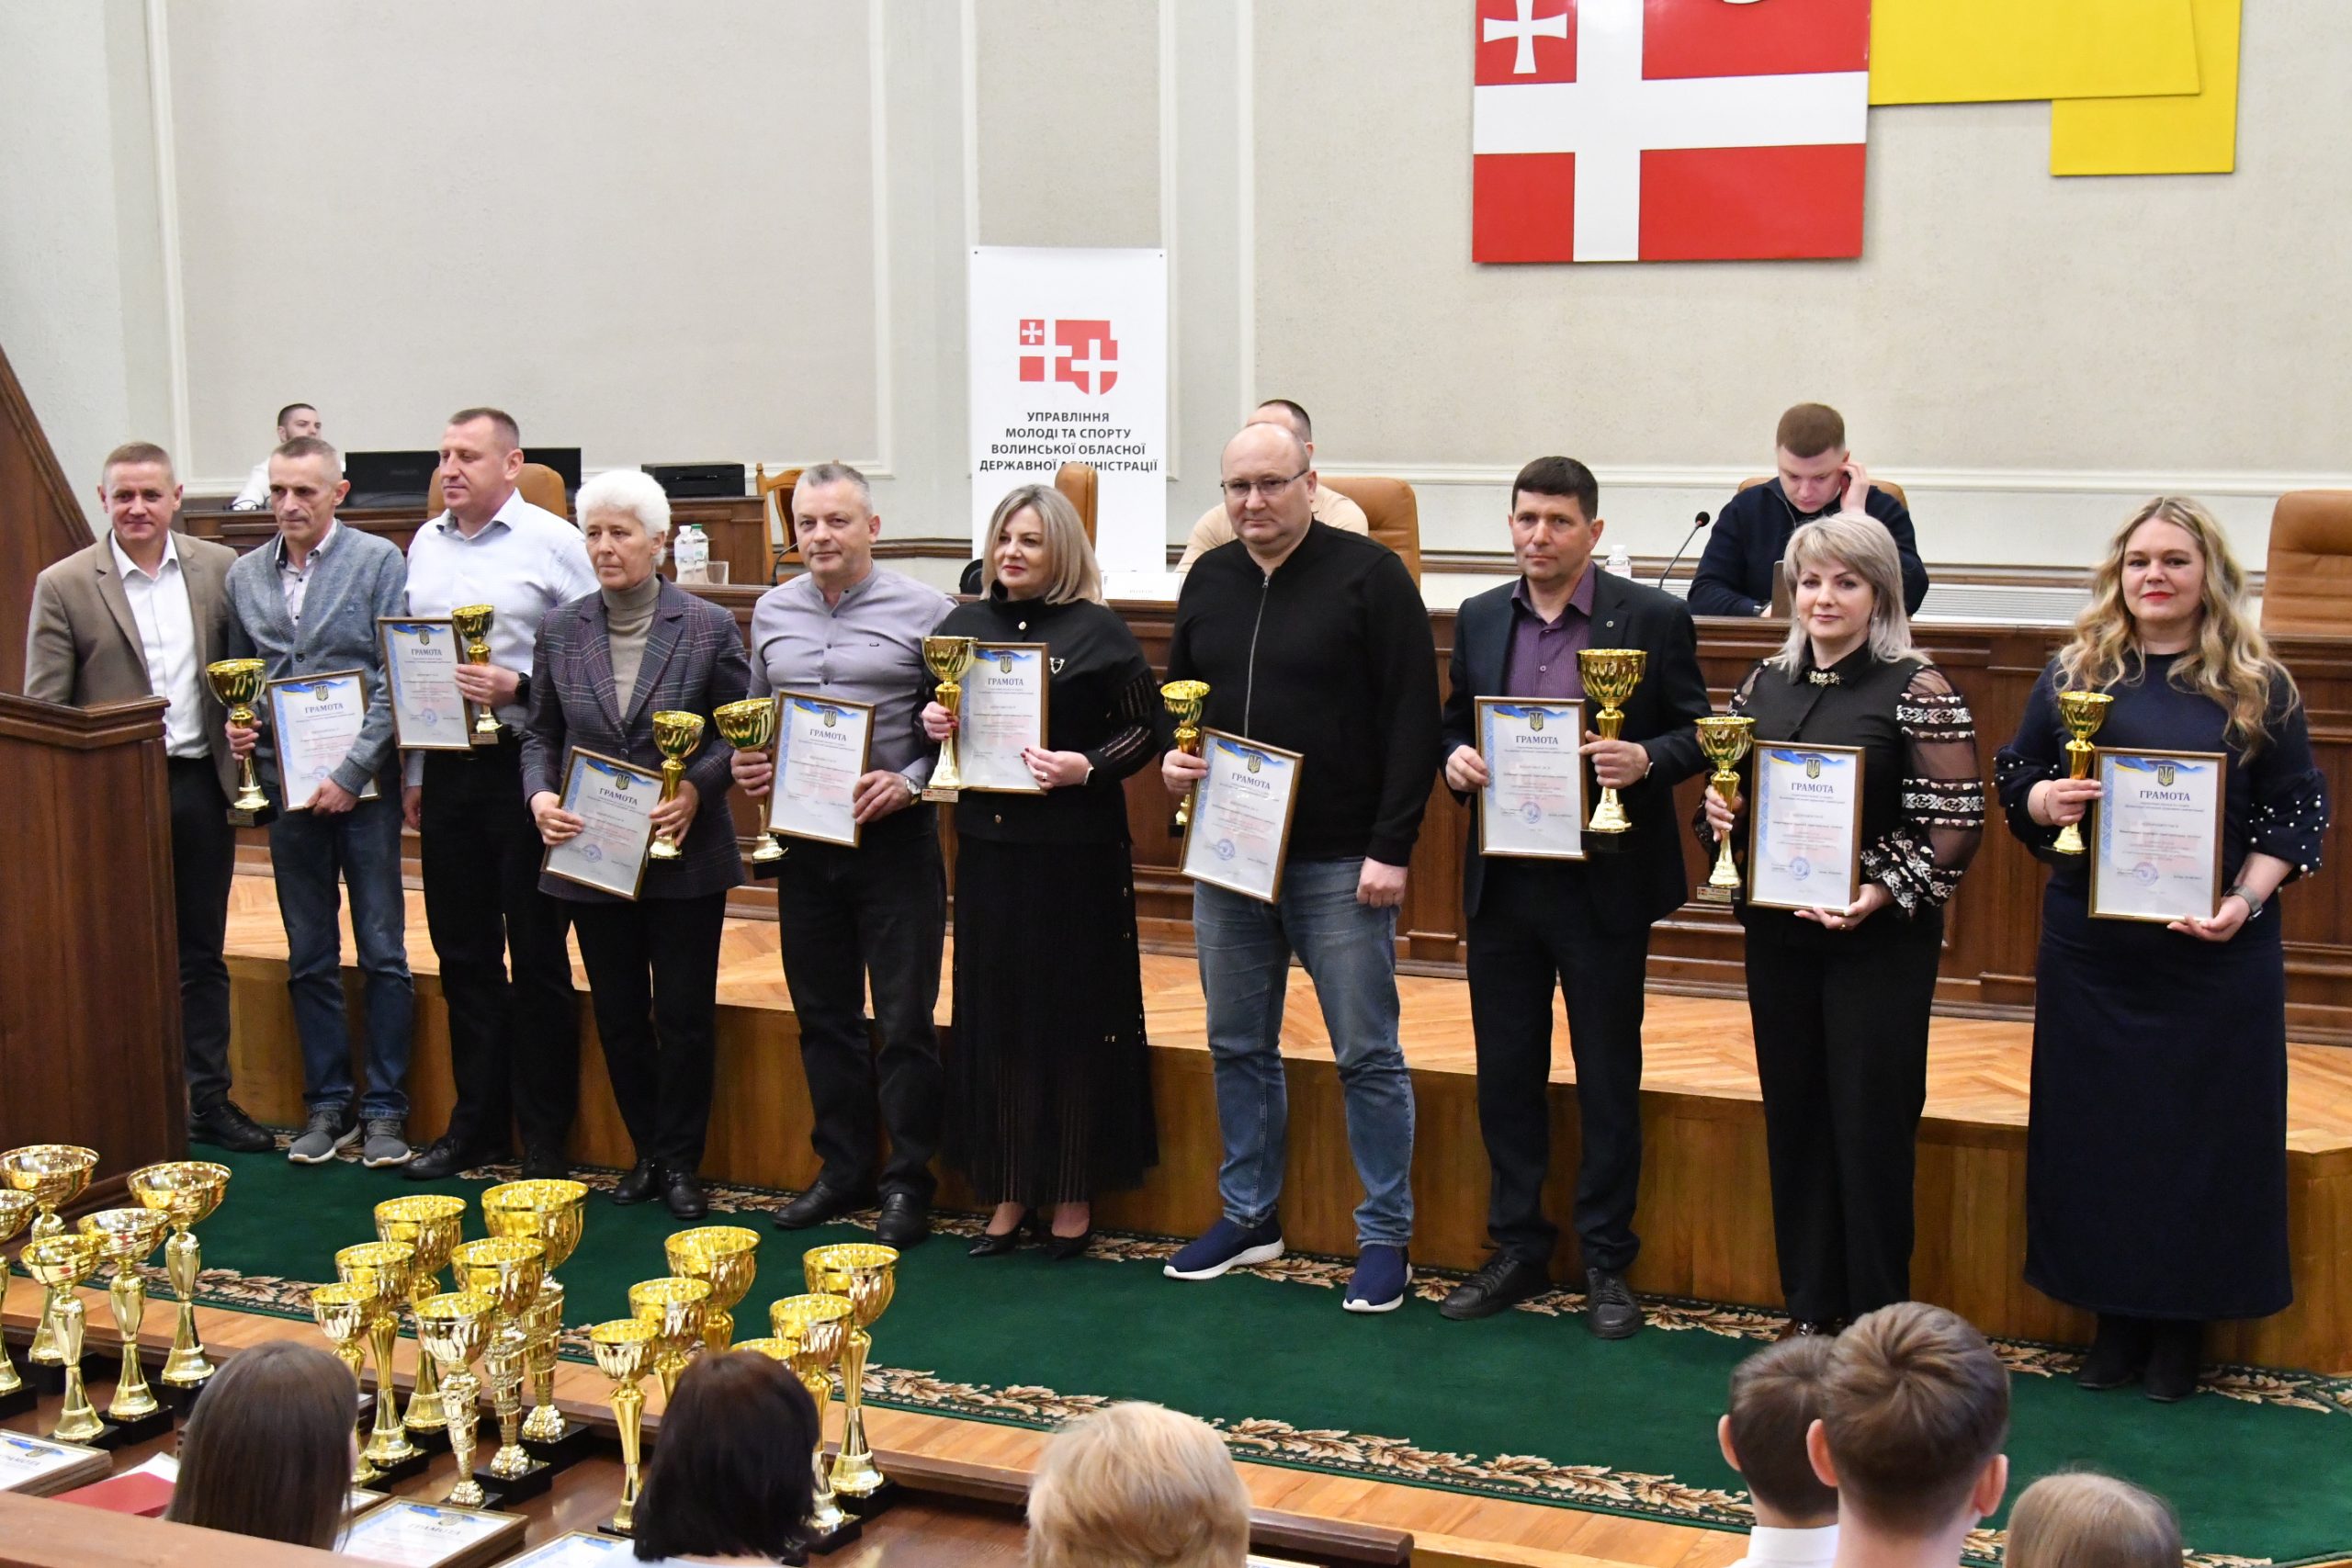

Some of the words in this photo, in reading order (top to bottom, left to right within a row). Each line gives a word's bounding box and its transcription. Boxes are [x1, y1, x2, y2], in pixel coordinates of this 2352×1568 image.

[1027, 412, 1109, 422] УПРАВЛІННЯ
[1006, 428, 1057, 440] МОЛОДІ
[1061, 428, 1076, 438] ТА
[1080, 429, 1131, 438] СПОРТУ
[991, 443, 1076, 455] ВОЛИНСЬКОЇ
[1079, 443, 1146, 455] ОБЛАСНОЇ
[979, 459, 1057, 472] ДЕРЖАВНОЇ
[988, 677, 1023, 685] ГРАМОТА
[304, 703, 344, 714] ГРАМОТА
[809, 728, 846, 741] ГРАМОТА
[1516, 735, 1558, 745] ГРАМОТА
[1231, 773, 1271, 790] ГРАМОТА
[1791, 783, 1834, 794] ГРАМОТА
[599, 787, 638, 806] ГРАМОТА
[2140, 790, 2190, 801] ГРАМОТА
